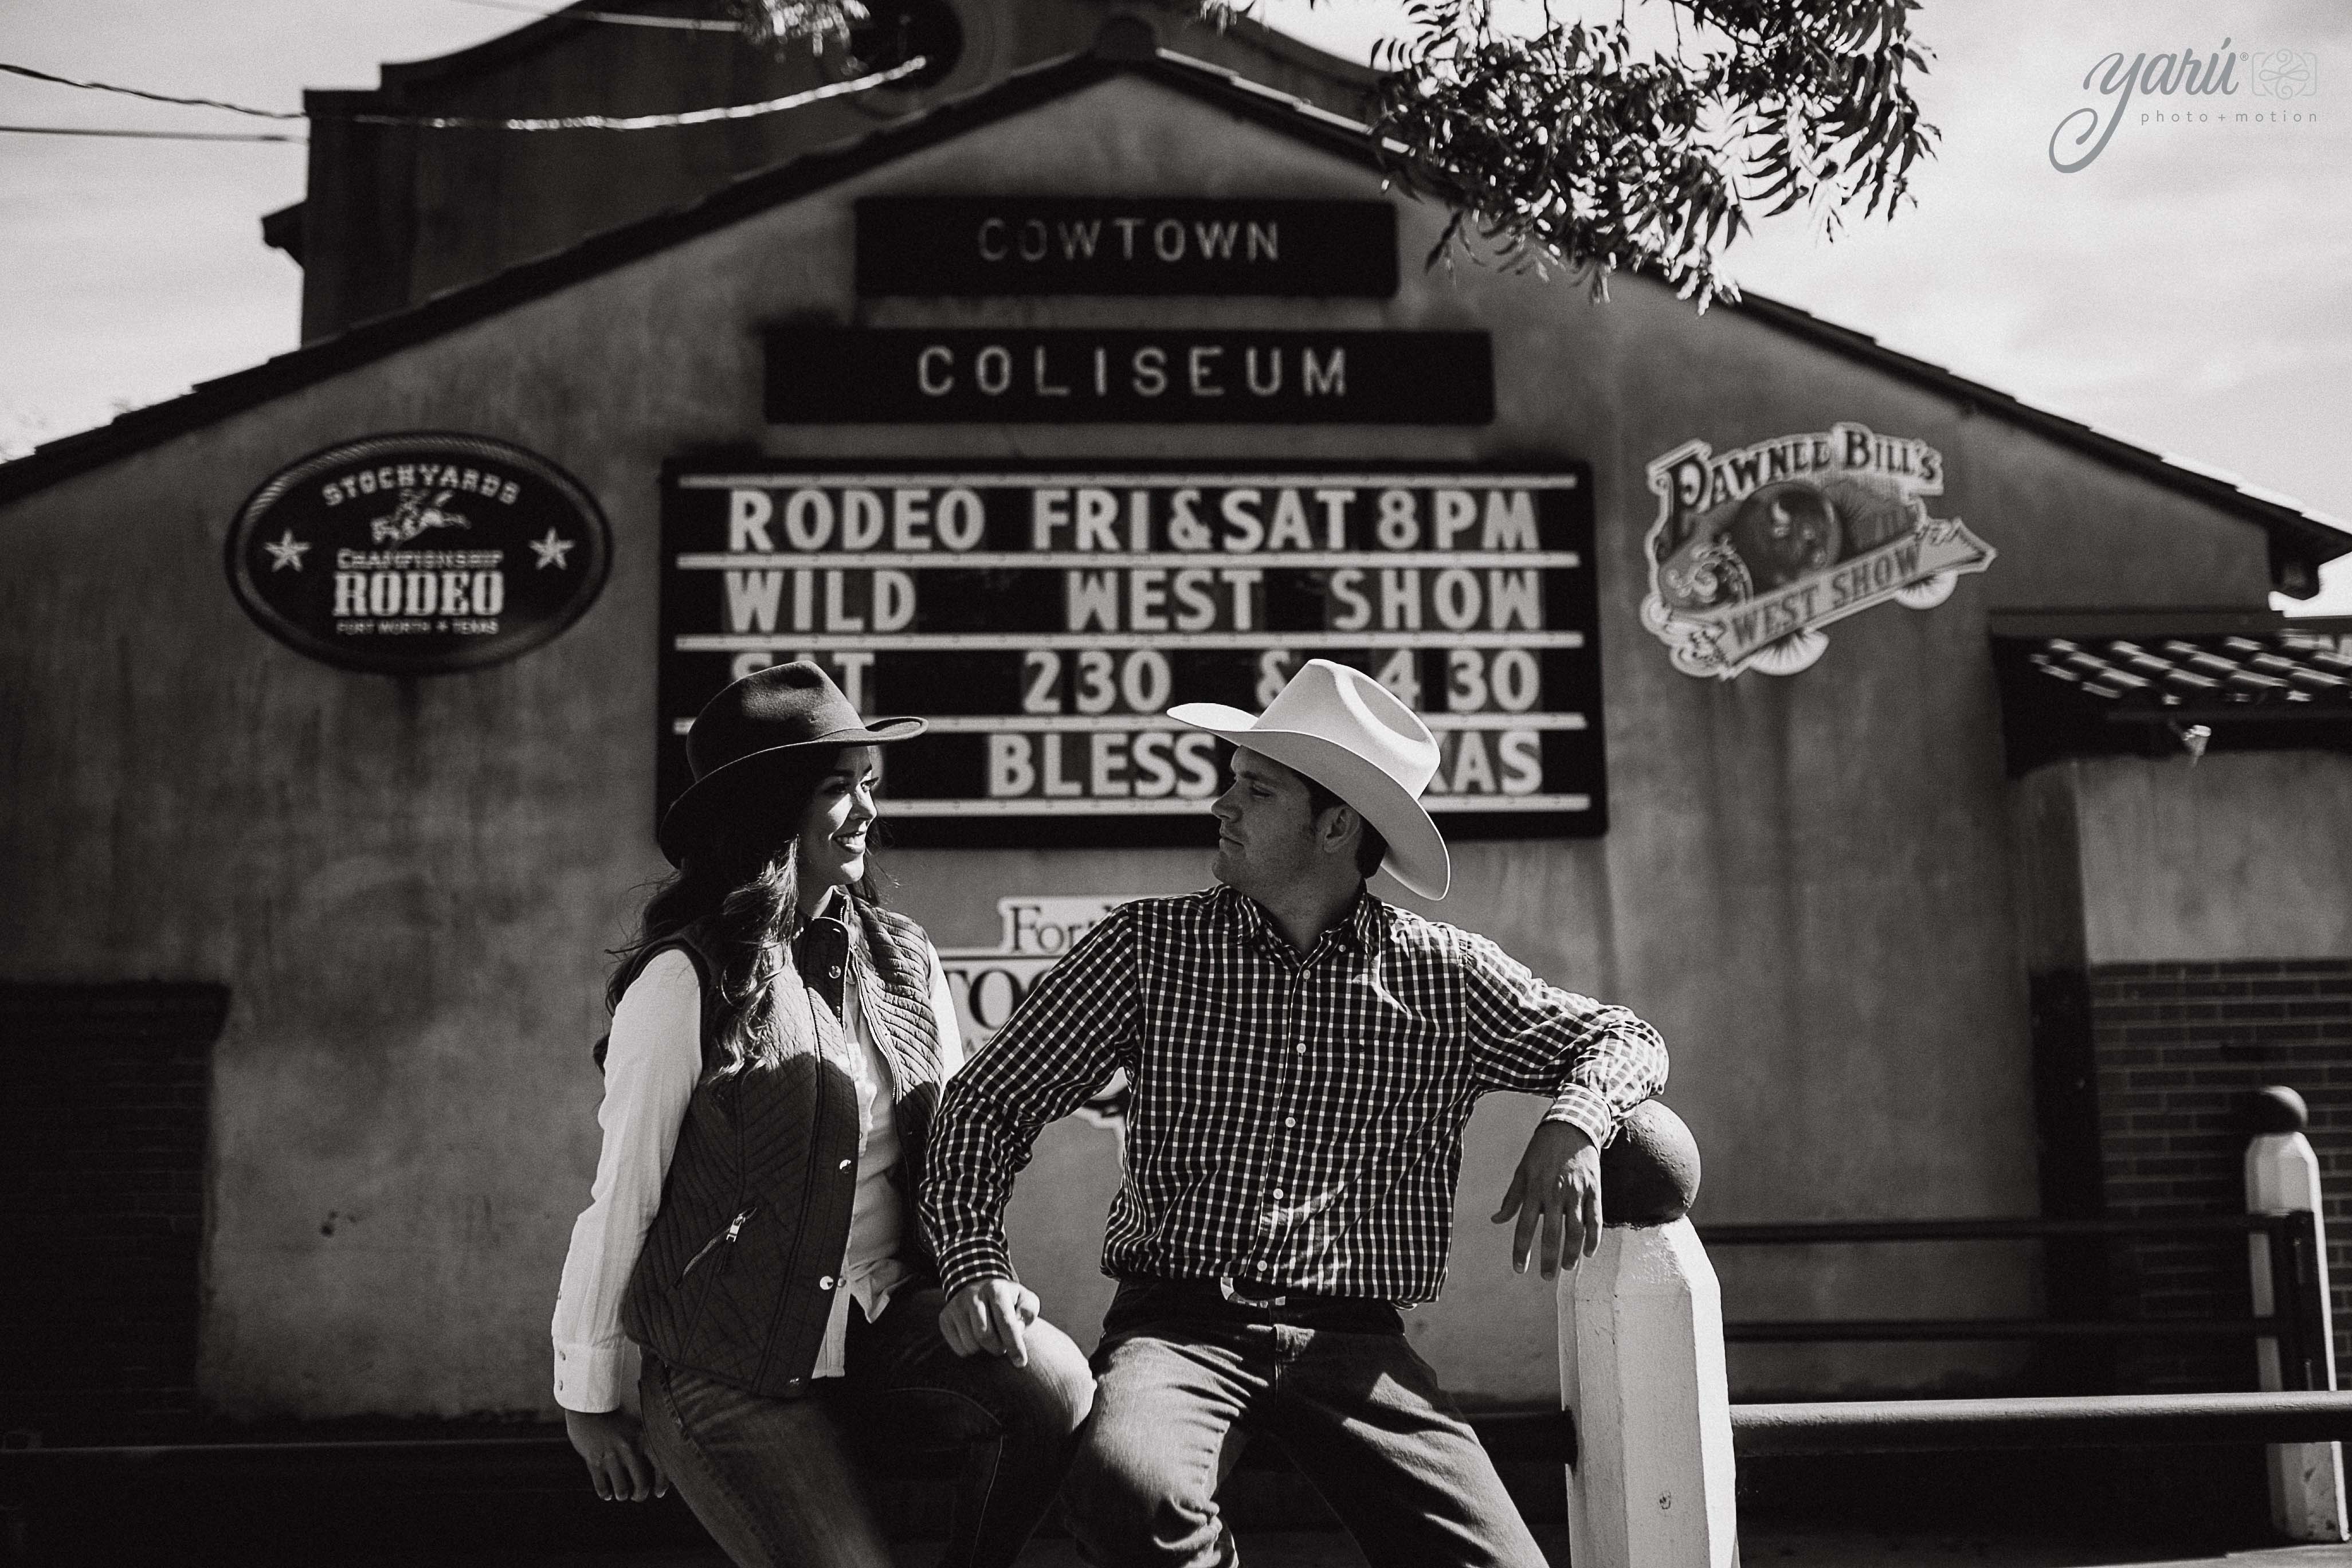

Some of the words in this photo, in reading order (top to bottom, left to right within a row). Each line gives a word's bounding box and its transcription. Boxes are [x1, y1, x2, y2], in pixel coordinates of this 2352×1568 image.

[977, 218, 1280, 262] COWTOWN
[918, 345, 1347, 395] COLISEUM
[729, 488, 986, 552] RODEO
[333, 571, 504, 617] RODEO
[724, 570, 916, 632] WILD
[1067, 569, 1262, 632] WEST
[1330, 569, 1542, 630] SHOW
[1731, 582, 1819, 646] WEST
[1833, 543, 1922, 606] SHOW
[1024, 650, 1171, 714] 230
[989, 732, 1218, 797] BLESS
